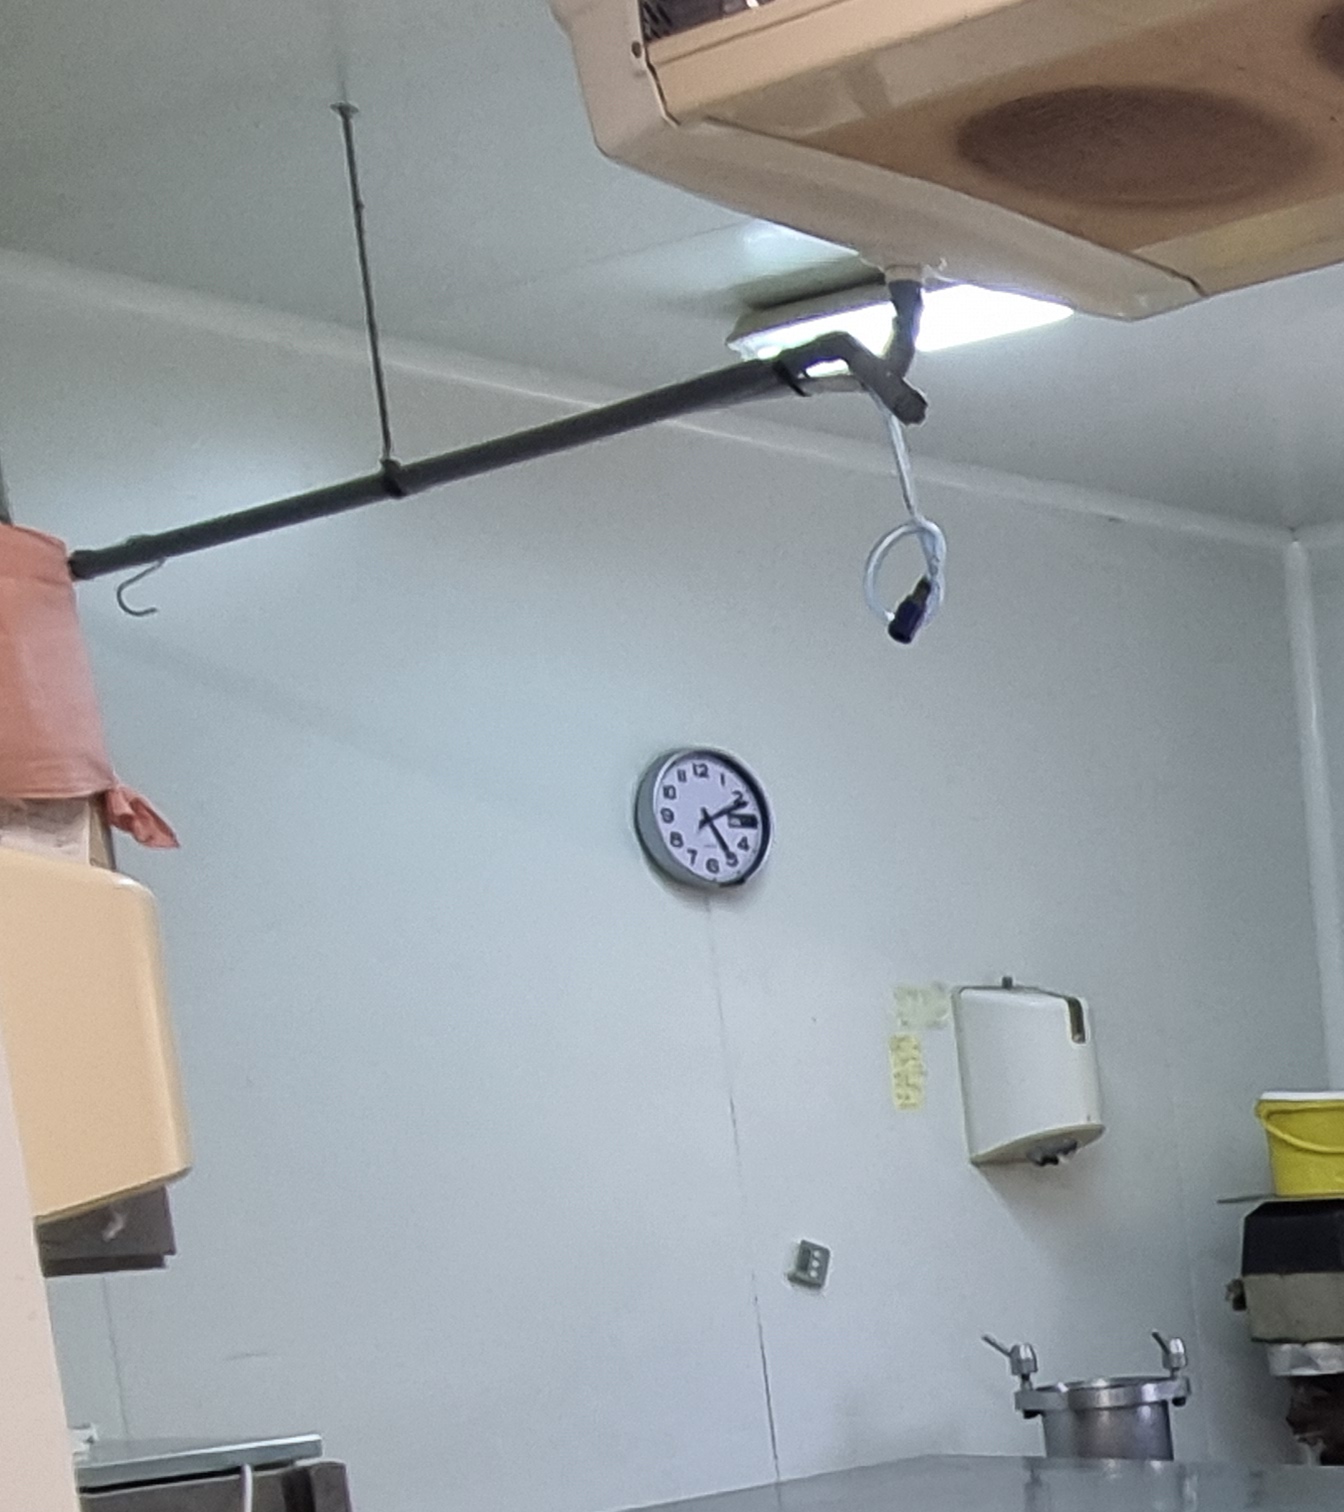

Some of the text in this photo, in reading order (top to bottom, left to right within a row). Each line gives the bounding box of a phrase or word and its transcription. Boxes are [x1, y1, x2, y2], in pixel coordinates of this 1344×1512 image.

[692, 763, 709, 779] 12
[720, 773, 726, 787] 1
[660, 808, 675, 824] 9
[670, 831, 684, 848] 8
[737, 836, 750, 852] 4
[687, 849, 698, 866] 7
[705, 858, 720, 874] 6
